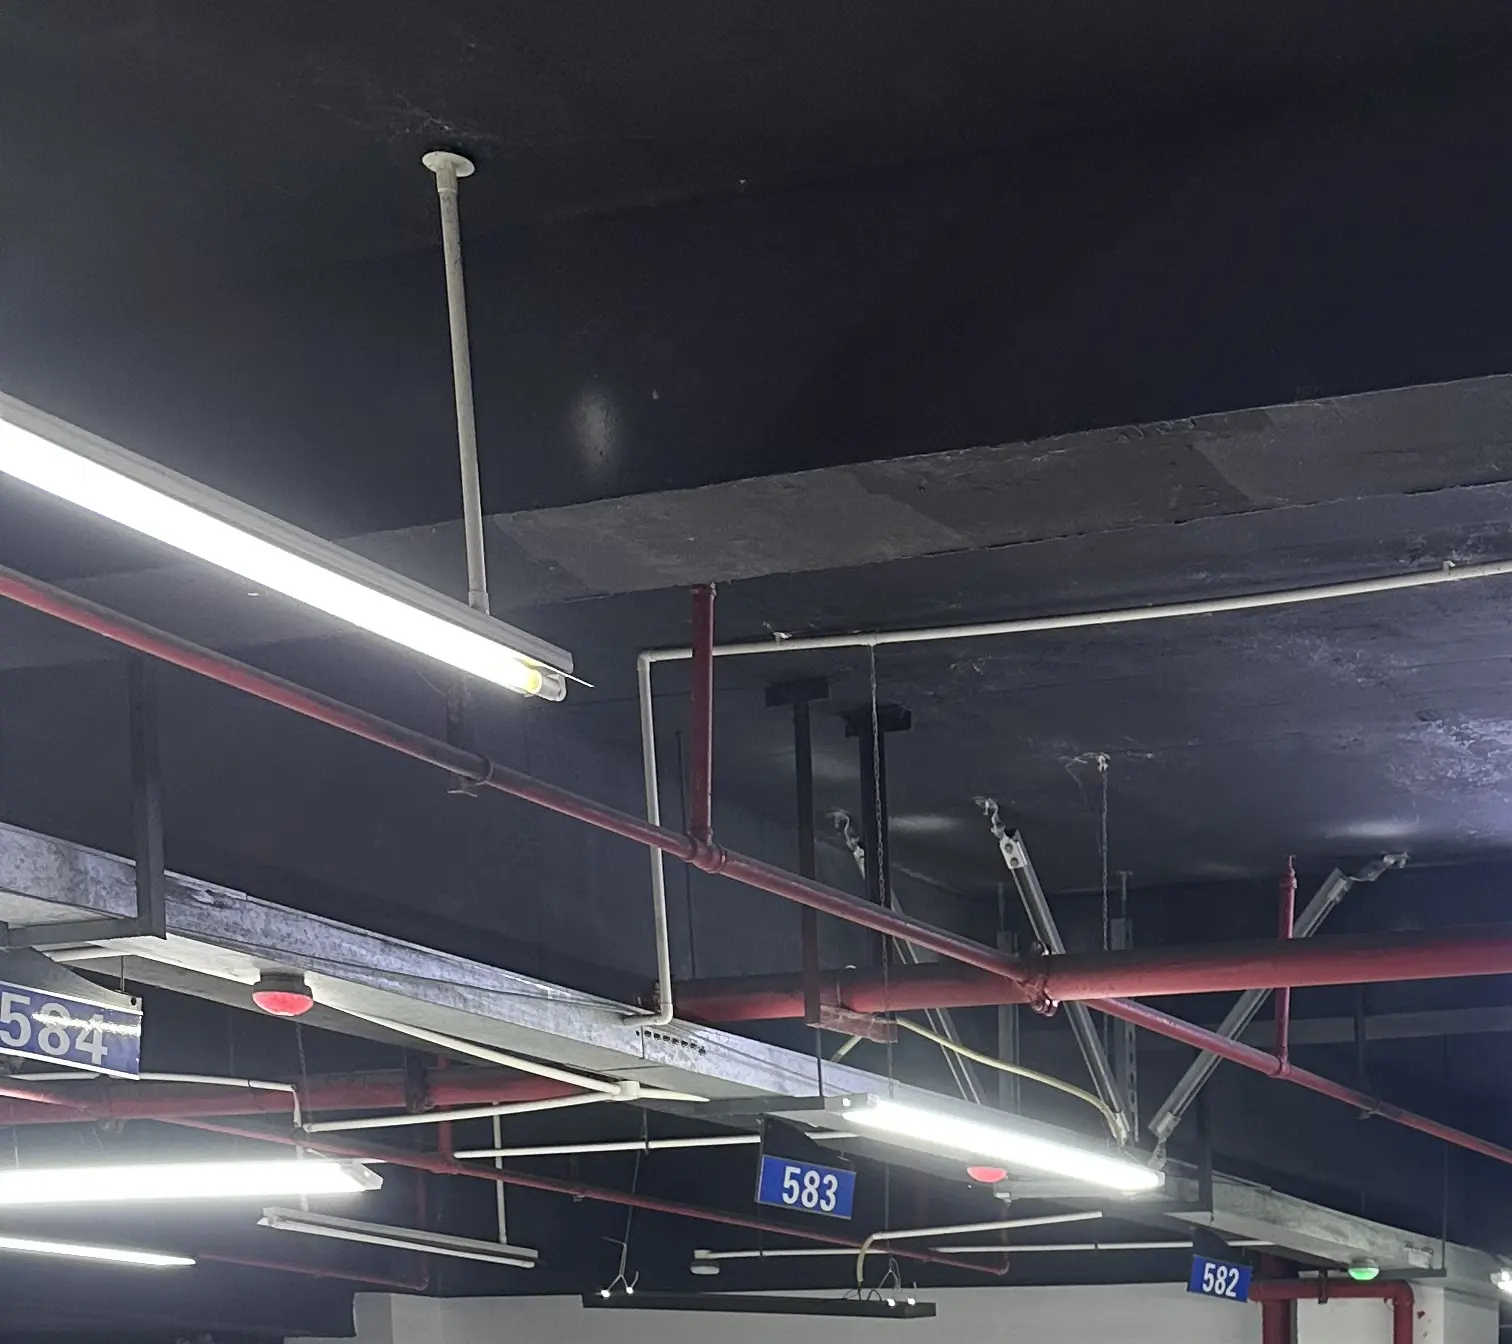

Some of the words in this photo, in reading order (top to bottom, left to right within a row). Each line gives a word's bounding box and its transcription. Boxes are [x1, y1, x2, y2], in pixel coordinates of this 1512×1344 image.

[0, 991, 109, 1066] 584
[782, 1165, 839, 1212] 583
[1202, 1262, 1240, 1298] 582
